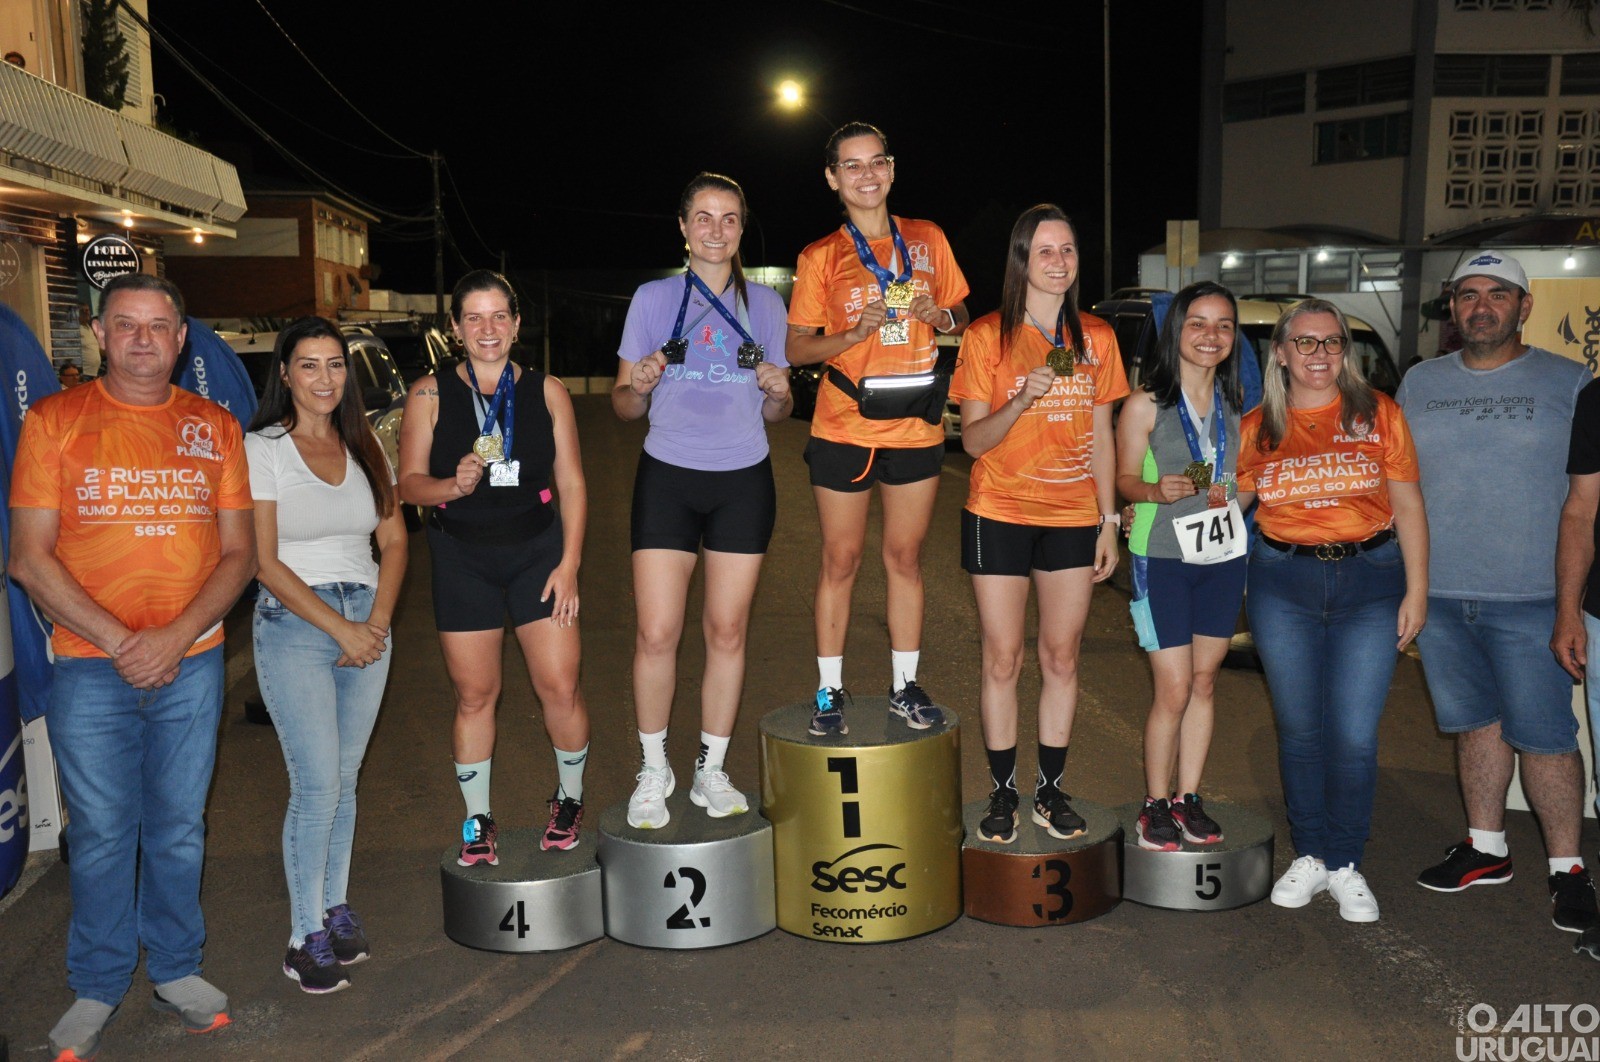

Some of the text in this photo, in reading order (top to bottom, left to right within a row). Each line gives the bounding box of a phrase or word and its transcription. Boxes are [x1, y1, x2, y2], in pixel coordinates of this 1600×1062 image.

[1575, 220, 1600, 241] A
[94, 245, 129, 255] HOTEL
[87, 260, 136, 268] RESTAURANTE
[844, 299, 864, 314] DE
[847, 314, 862, 323] RU
[1039, 400, 1060, 408] AOS
[1063, 399, 1077, 407] 60
[1427, 395, 1535, 410] Calvin Klein Jeans
[1047, 413, 1073, 422] sesc
[1281, 452, 1369, 471] RÚSTICA
[110, 467, 206, 484] RÚSTICA
[1277, 463, 1380, 485] PLANALTO
[76, 485, 210, 501] DE PLANALTO
[1290, 483, 1320, 495] AOS
[1324, 481, 1346, 491] 60
[1350, 478, 1381, 490] ANOS
[78, 505, 212, 516] RUMO AOS 60 ANOS
[1303, 498, 1339, 509] sesc
[134, 525, 176, 537] sesc
[1186, 511, 1235, 553] 741
[827, 757, 861, 838] 1
[1036, 803, 1051, 820] FILA
[811, 861, 907, 893] Sesc
[1195, 863, 1221, 900] 5
[1032, 859, 1074, 921] 3
[663, 867, 711, 930] 2
[811, 903, 908, 919] Fecomércio
[499, 901, 530, 939] 4
[812, 922, 863, 938] Senac
